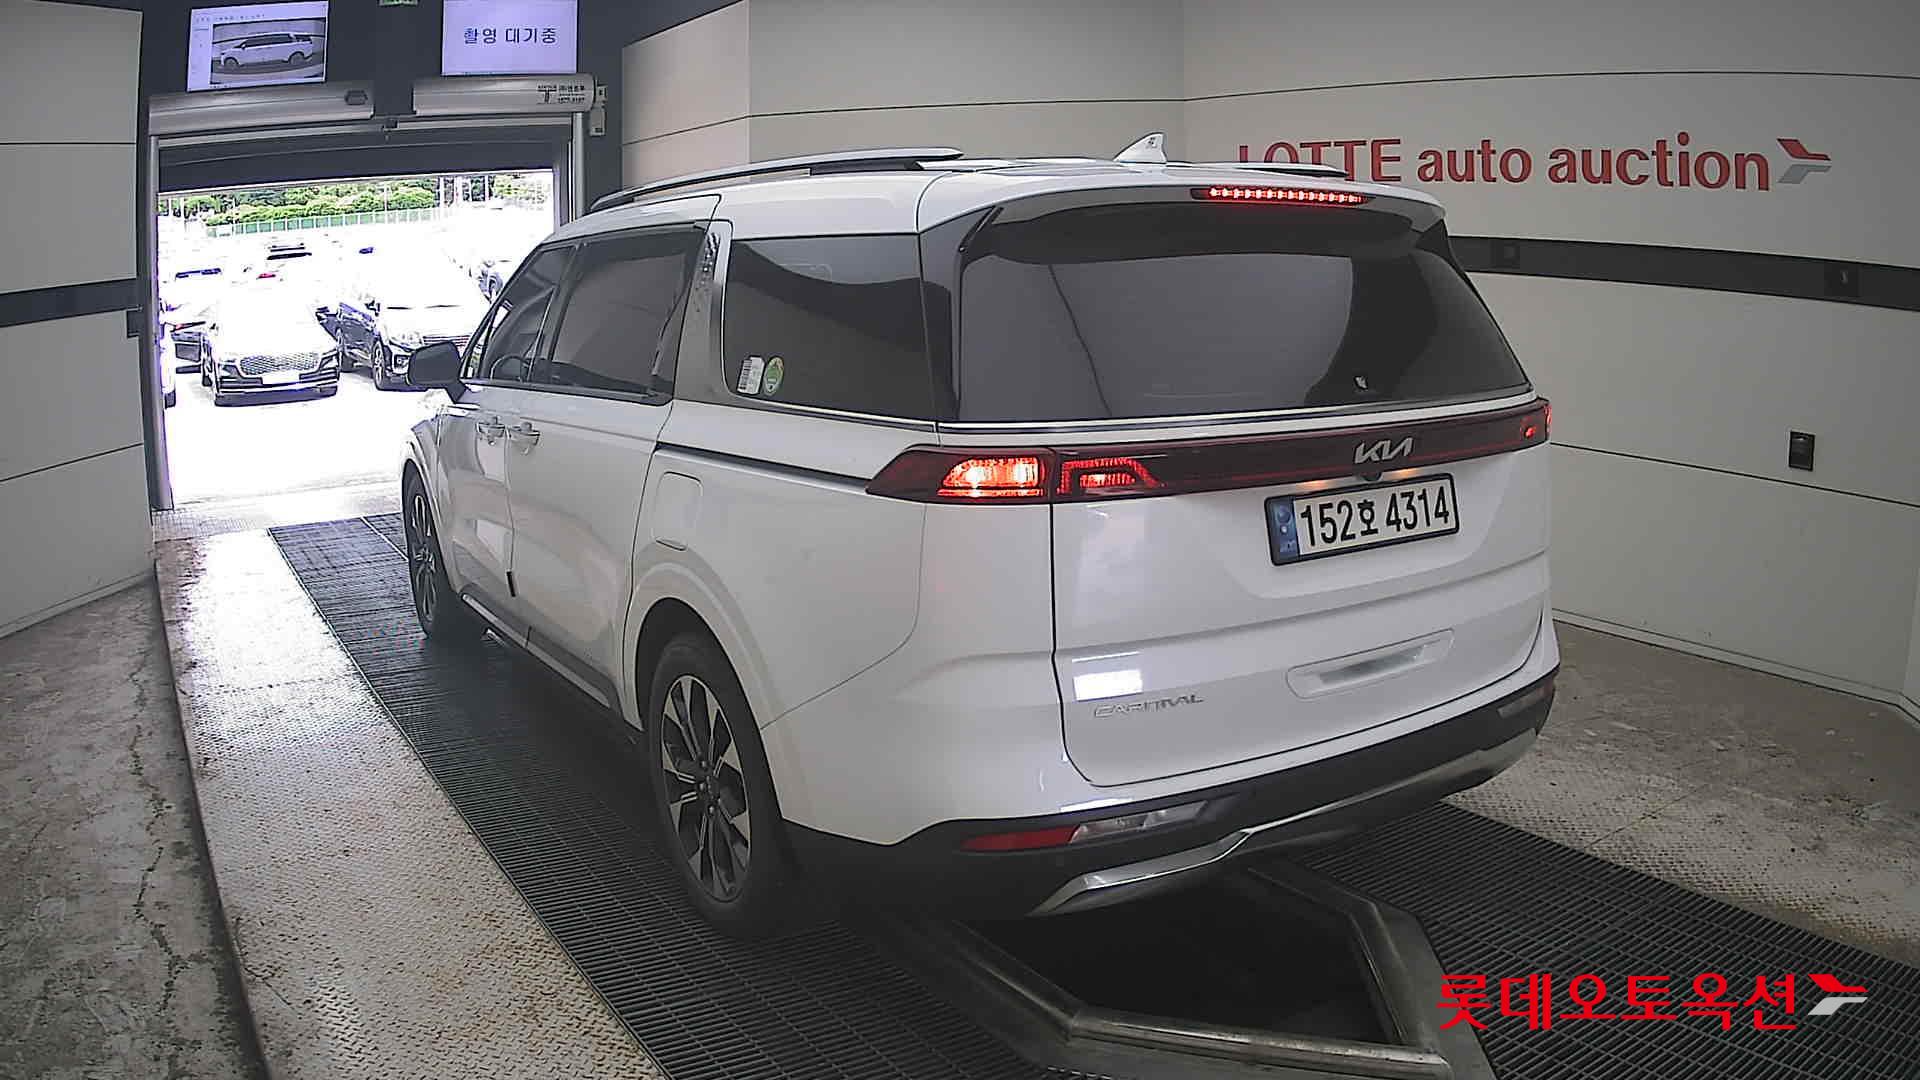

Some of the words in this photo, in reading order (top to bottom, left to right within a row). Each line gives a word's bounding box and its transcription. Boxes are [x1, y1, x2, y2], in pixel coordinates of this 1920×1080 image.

[463, 27, 497, 45] 촬영
[504, 27, 557, 45] 대기중
[1416, 139, 1532, 183] auto
[1548, 131, 1769, 191] auction
[1300, 498, 1379, 547] 152호
[1385, 485, 1450, 533] 4314
